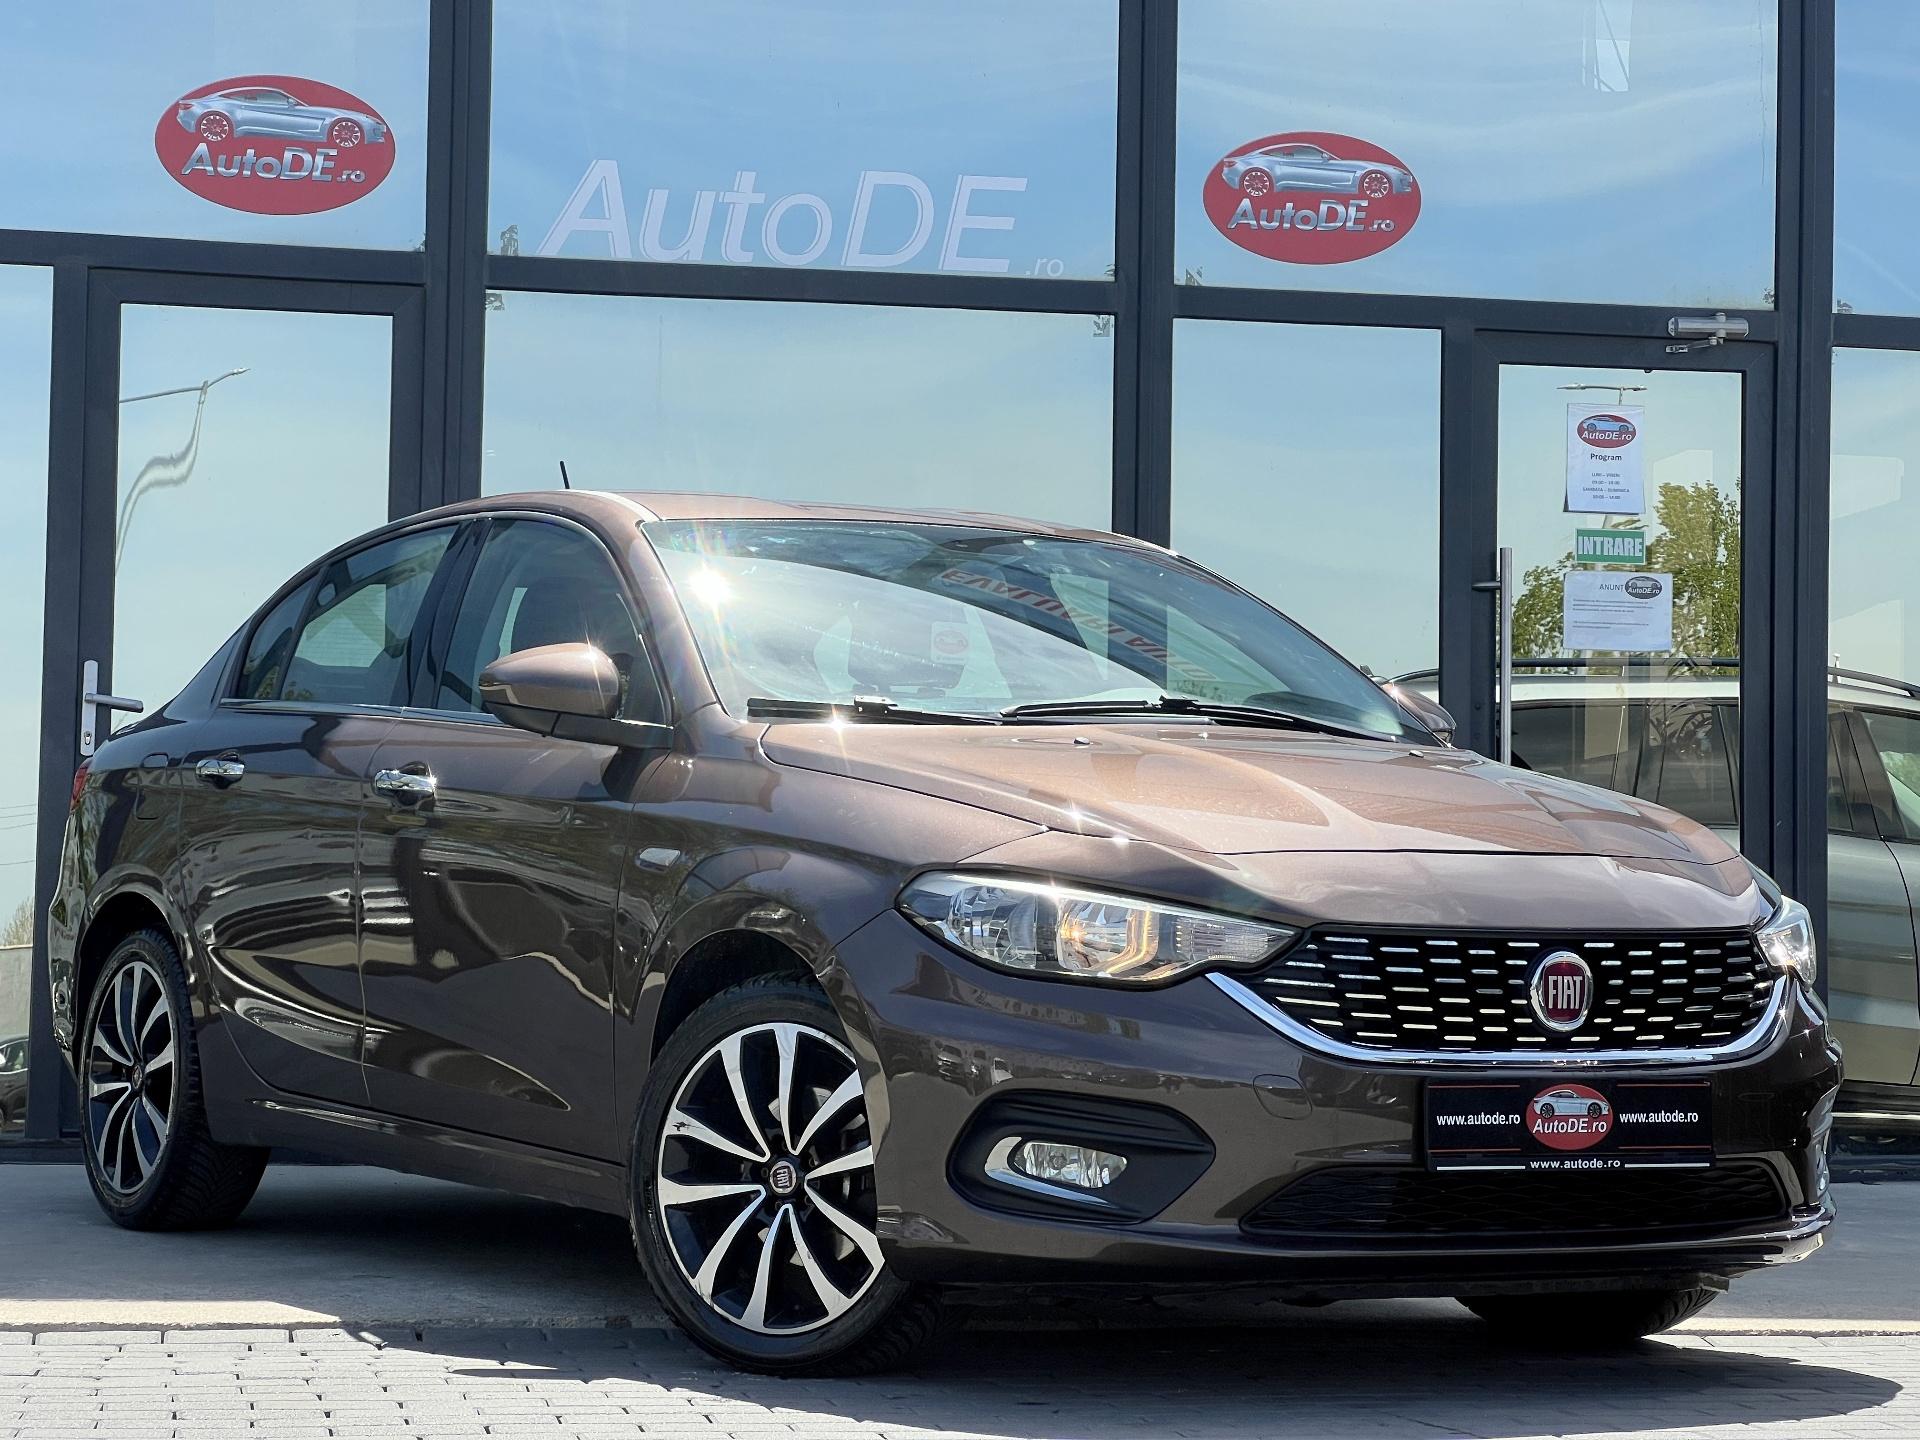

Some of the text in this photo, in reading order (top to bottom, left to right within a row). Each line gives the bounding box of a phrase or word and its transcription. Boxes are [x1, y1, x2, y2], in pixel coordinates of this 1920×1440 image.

[1582, 430, 1632, 441] AutoDE.ro
[1590, 453, 1622, 461] Program
[1578, 536, 1643, 557] INTRARE
[1548, 975, 1583, 1010] FIAT
[1436, 1112, 1521, 1126] www.autode.ro
[1619, 1110, 1699, 1124] www.autode.ro
[1533, 1118, 1608, 1134] AutoDE.ro
[1530, 1158, 1621, 1169] www.autode.ro
[776, 1168, 790, 1187] FIAT
